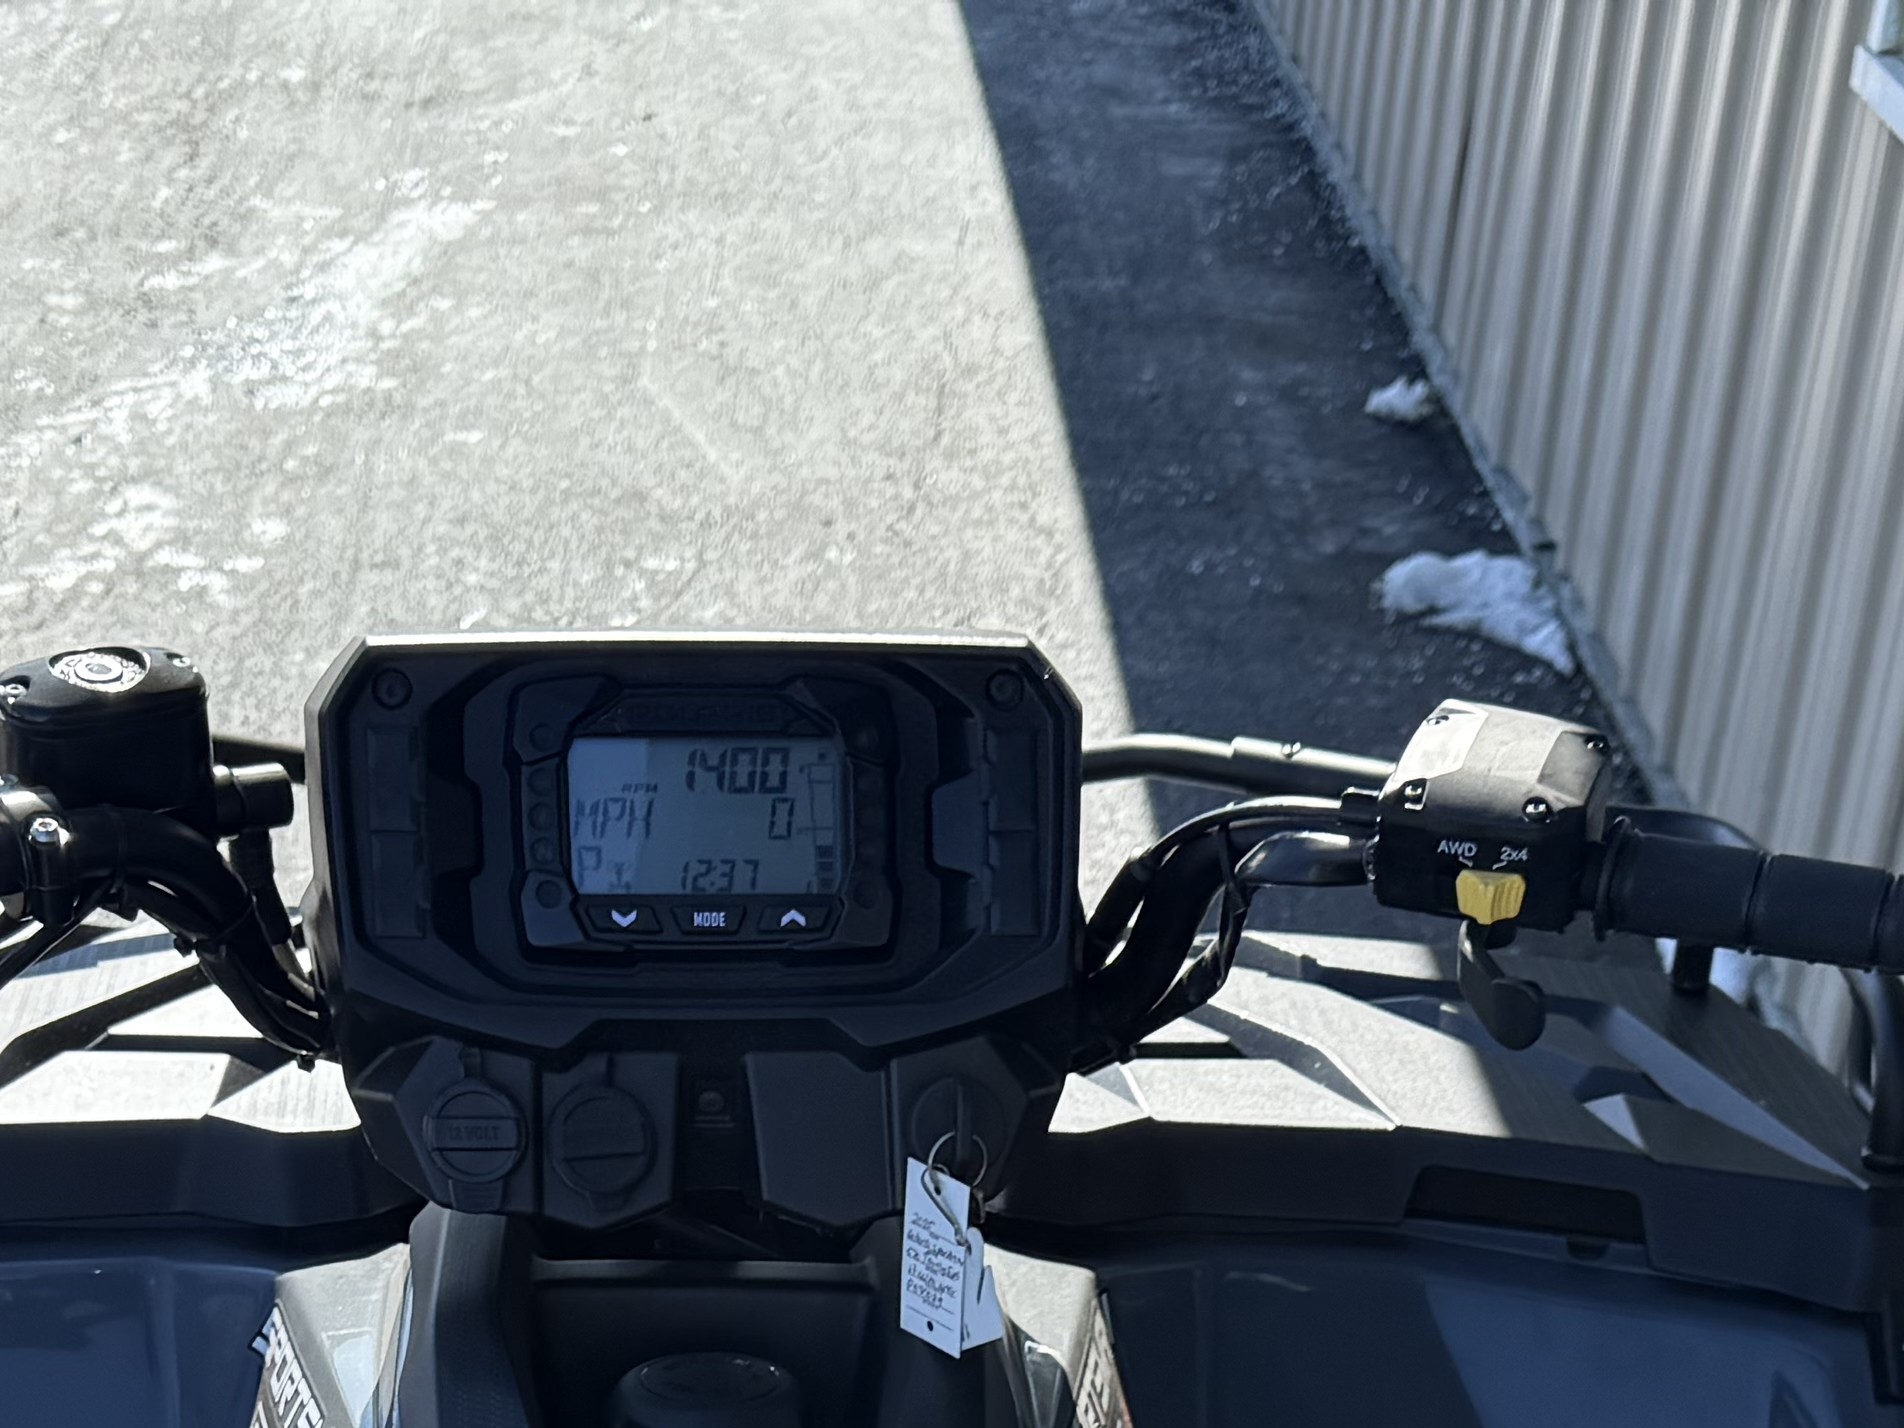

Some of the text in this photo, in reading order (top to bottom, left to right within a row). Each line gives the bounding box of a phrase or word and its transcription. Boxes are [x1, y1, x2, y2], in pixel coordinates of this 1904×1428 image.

[686, 748, 790, 794] 1400
[622, 783, 658, 794] RPM
[574, 797, 655, 839] MPH
[1437, 840, 1477, 857] AWD
[1500, 847, 1528, 861] 2x4
[693, 911, 727, 926] MODE
